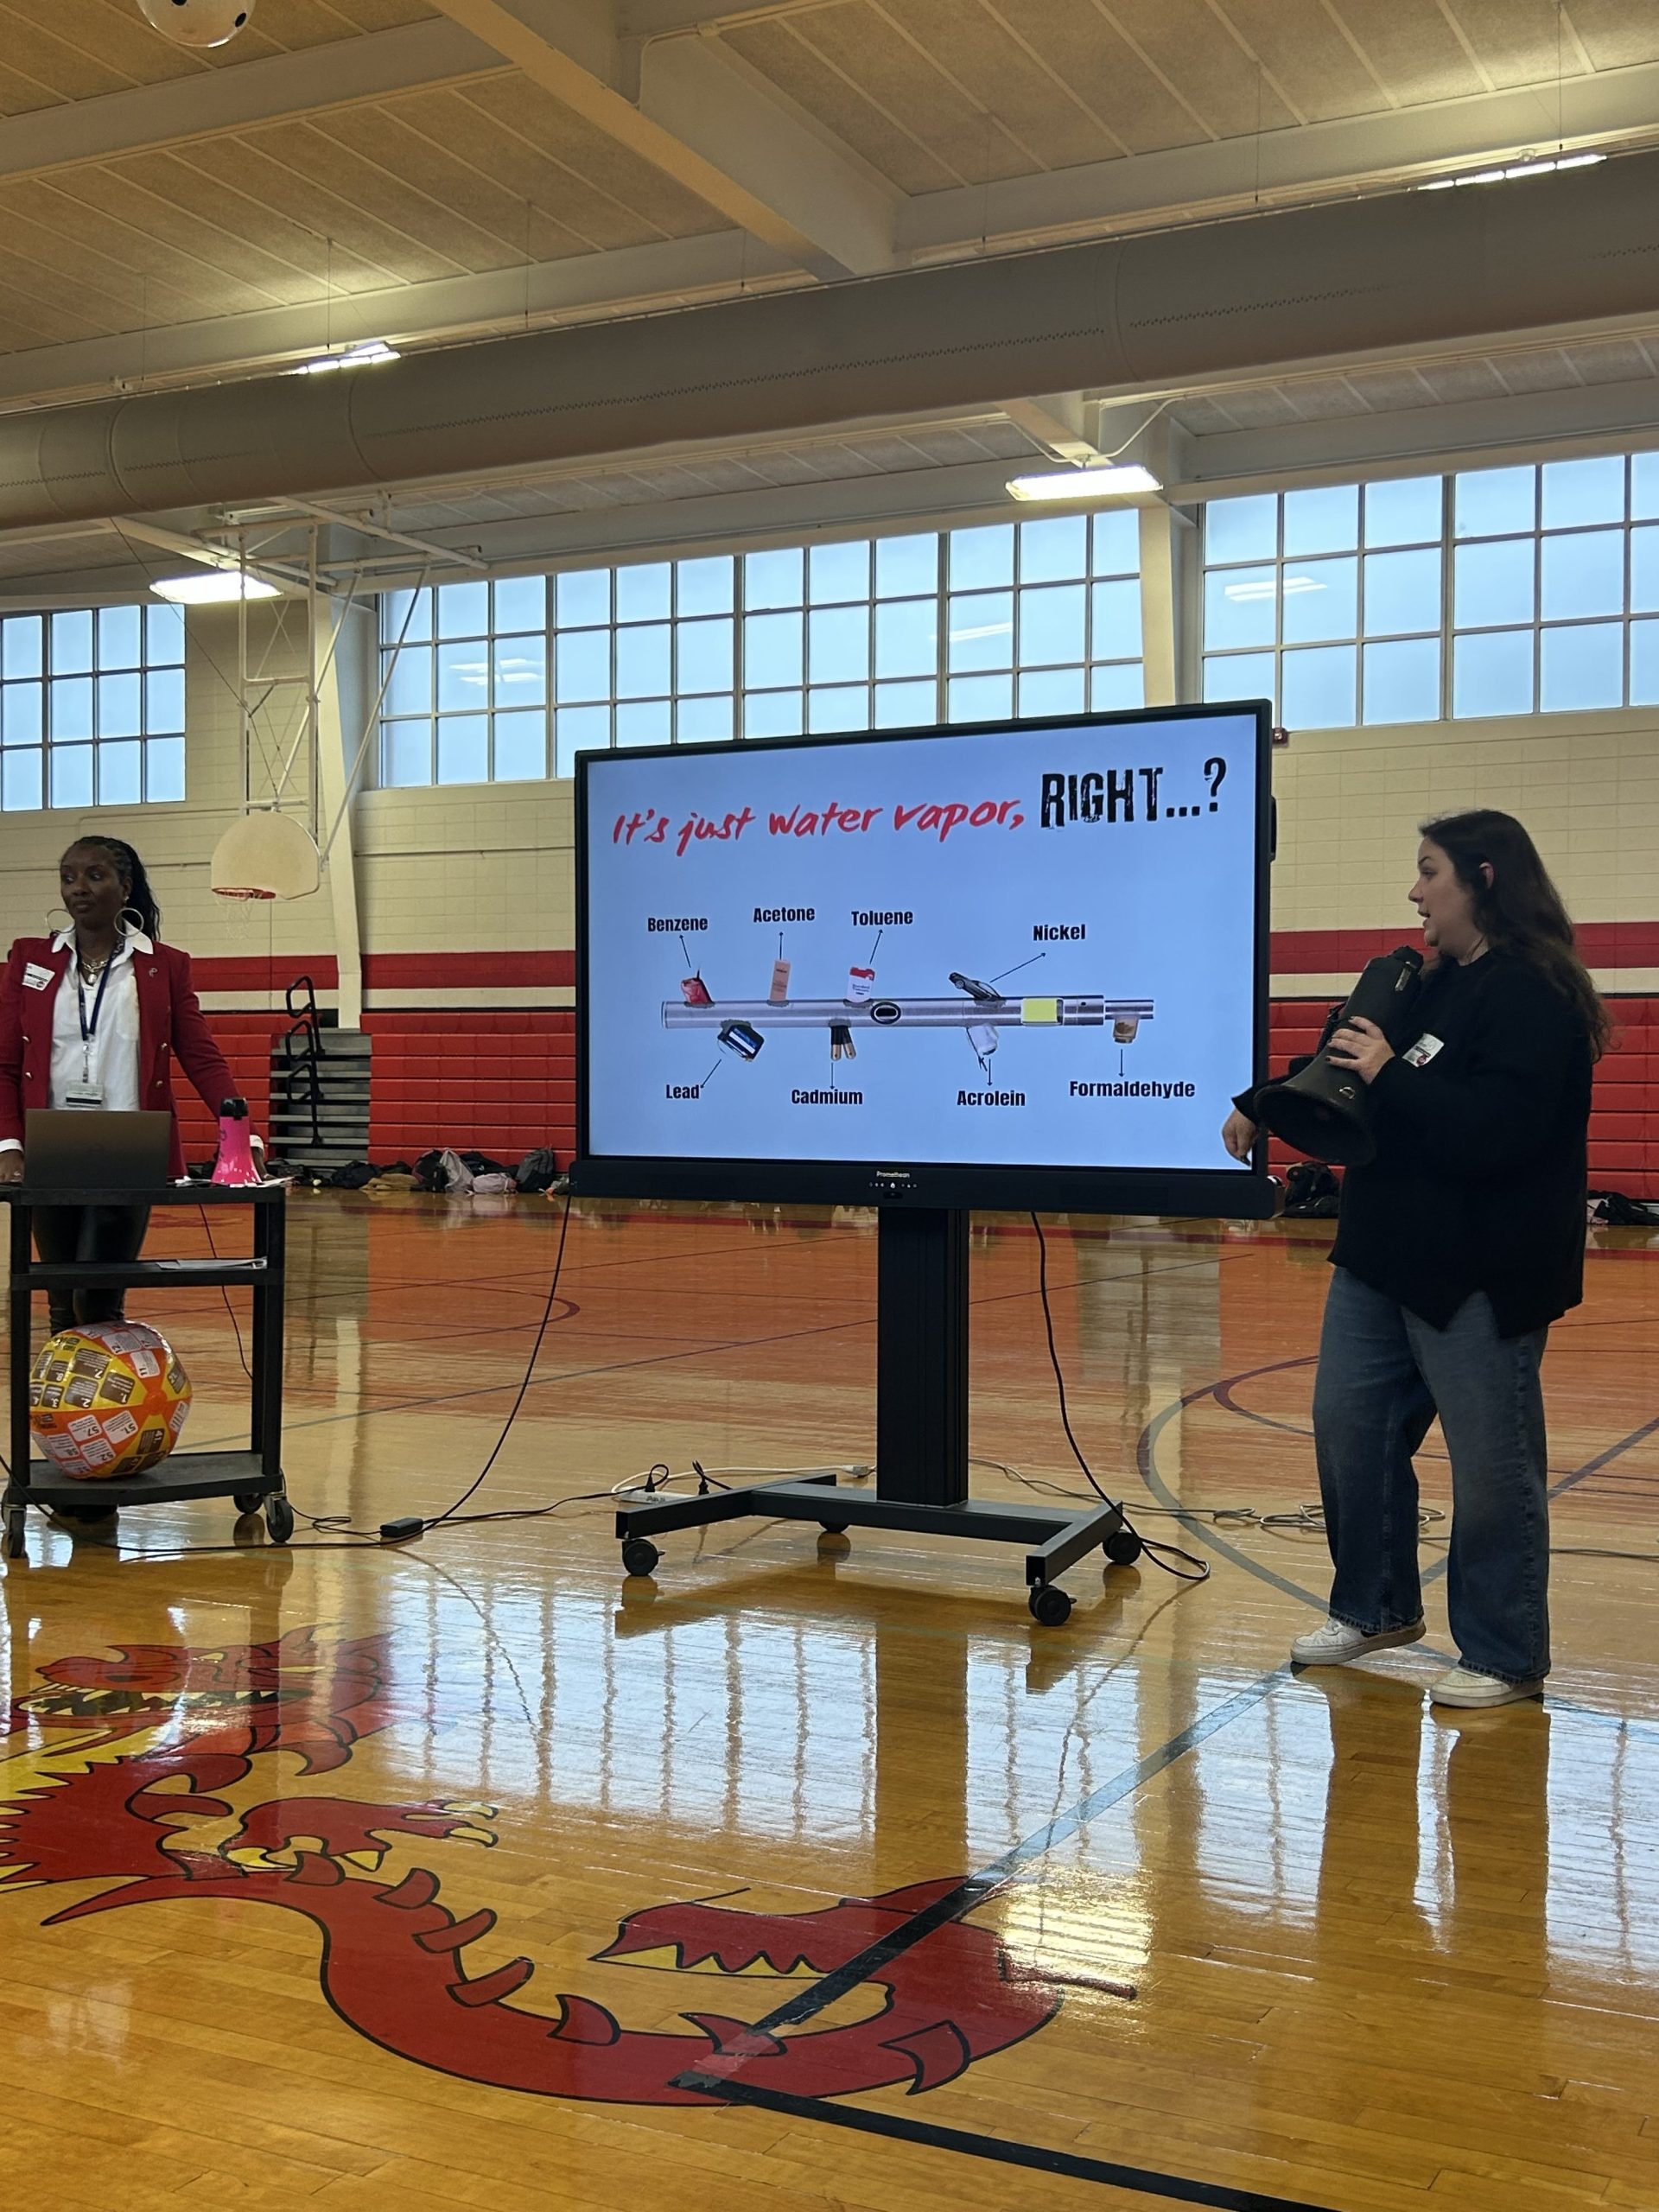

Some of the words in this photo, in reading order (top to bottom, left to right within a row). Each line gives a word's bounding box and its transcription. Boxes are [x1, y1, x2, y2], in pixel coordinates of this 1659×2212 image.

[613, 808, 670, 846] It's
[676, 806, 757, 857] just
[893, 798, 1026, 843] vapor,
[753, 906, 816, 923] Acetone
[850, 910, 914, 926] Toluene
[647, 917, 709, 932] Benzene
[1033, 924, 1086, 942] Nickel
[665, 1084, 700, 1100] Lead
[791, 1088, 863, 1105] Cadmium
[957, 1090, 1027, 1107] Acrolein
[1069, 1080, 1196, 1100] Formaldehyde
